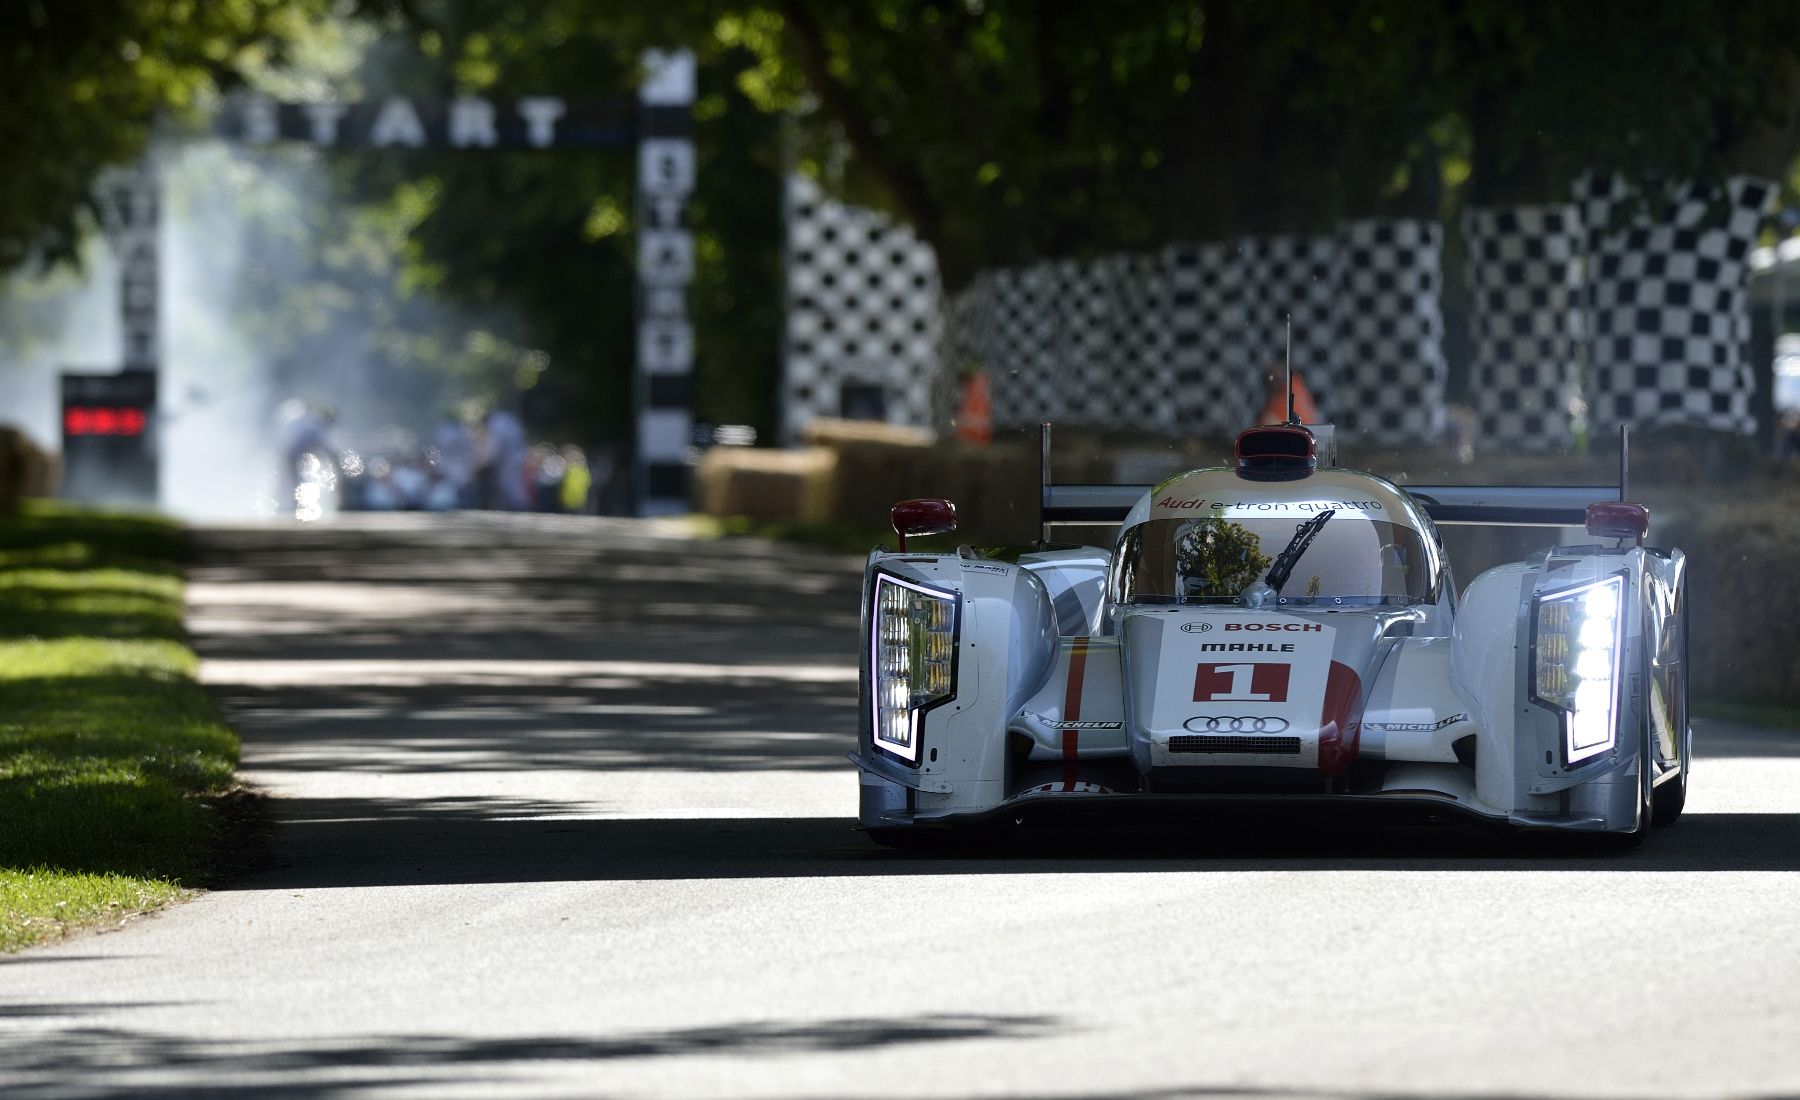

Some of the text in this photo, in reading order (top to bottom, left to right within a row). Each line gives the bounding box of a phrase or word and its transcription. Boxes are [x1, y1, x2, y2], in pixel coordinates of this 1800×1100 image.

[239, 96, 569, 148] START
[1157, 496, 1383, 513] Audi e-tron quattro
[1224, 623, 1322, 632] BOSCH
[1201, 643, 1295, 653] MAHLE
[1210, 663, 1271, 701] 1
[1040, 719, 1121, 729] MICHELIN
[1385, 714, 1463, 731] MICHELIN
